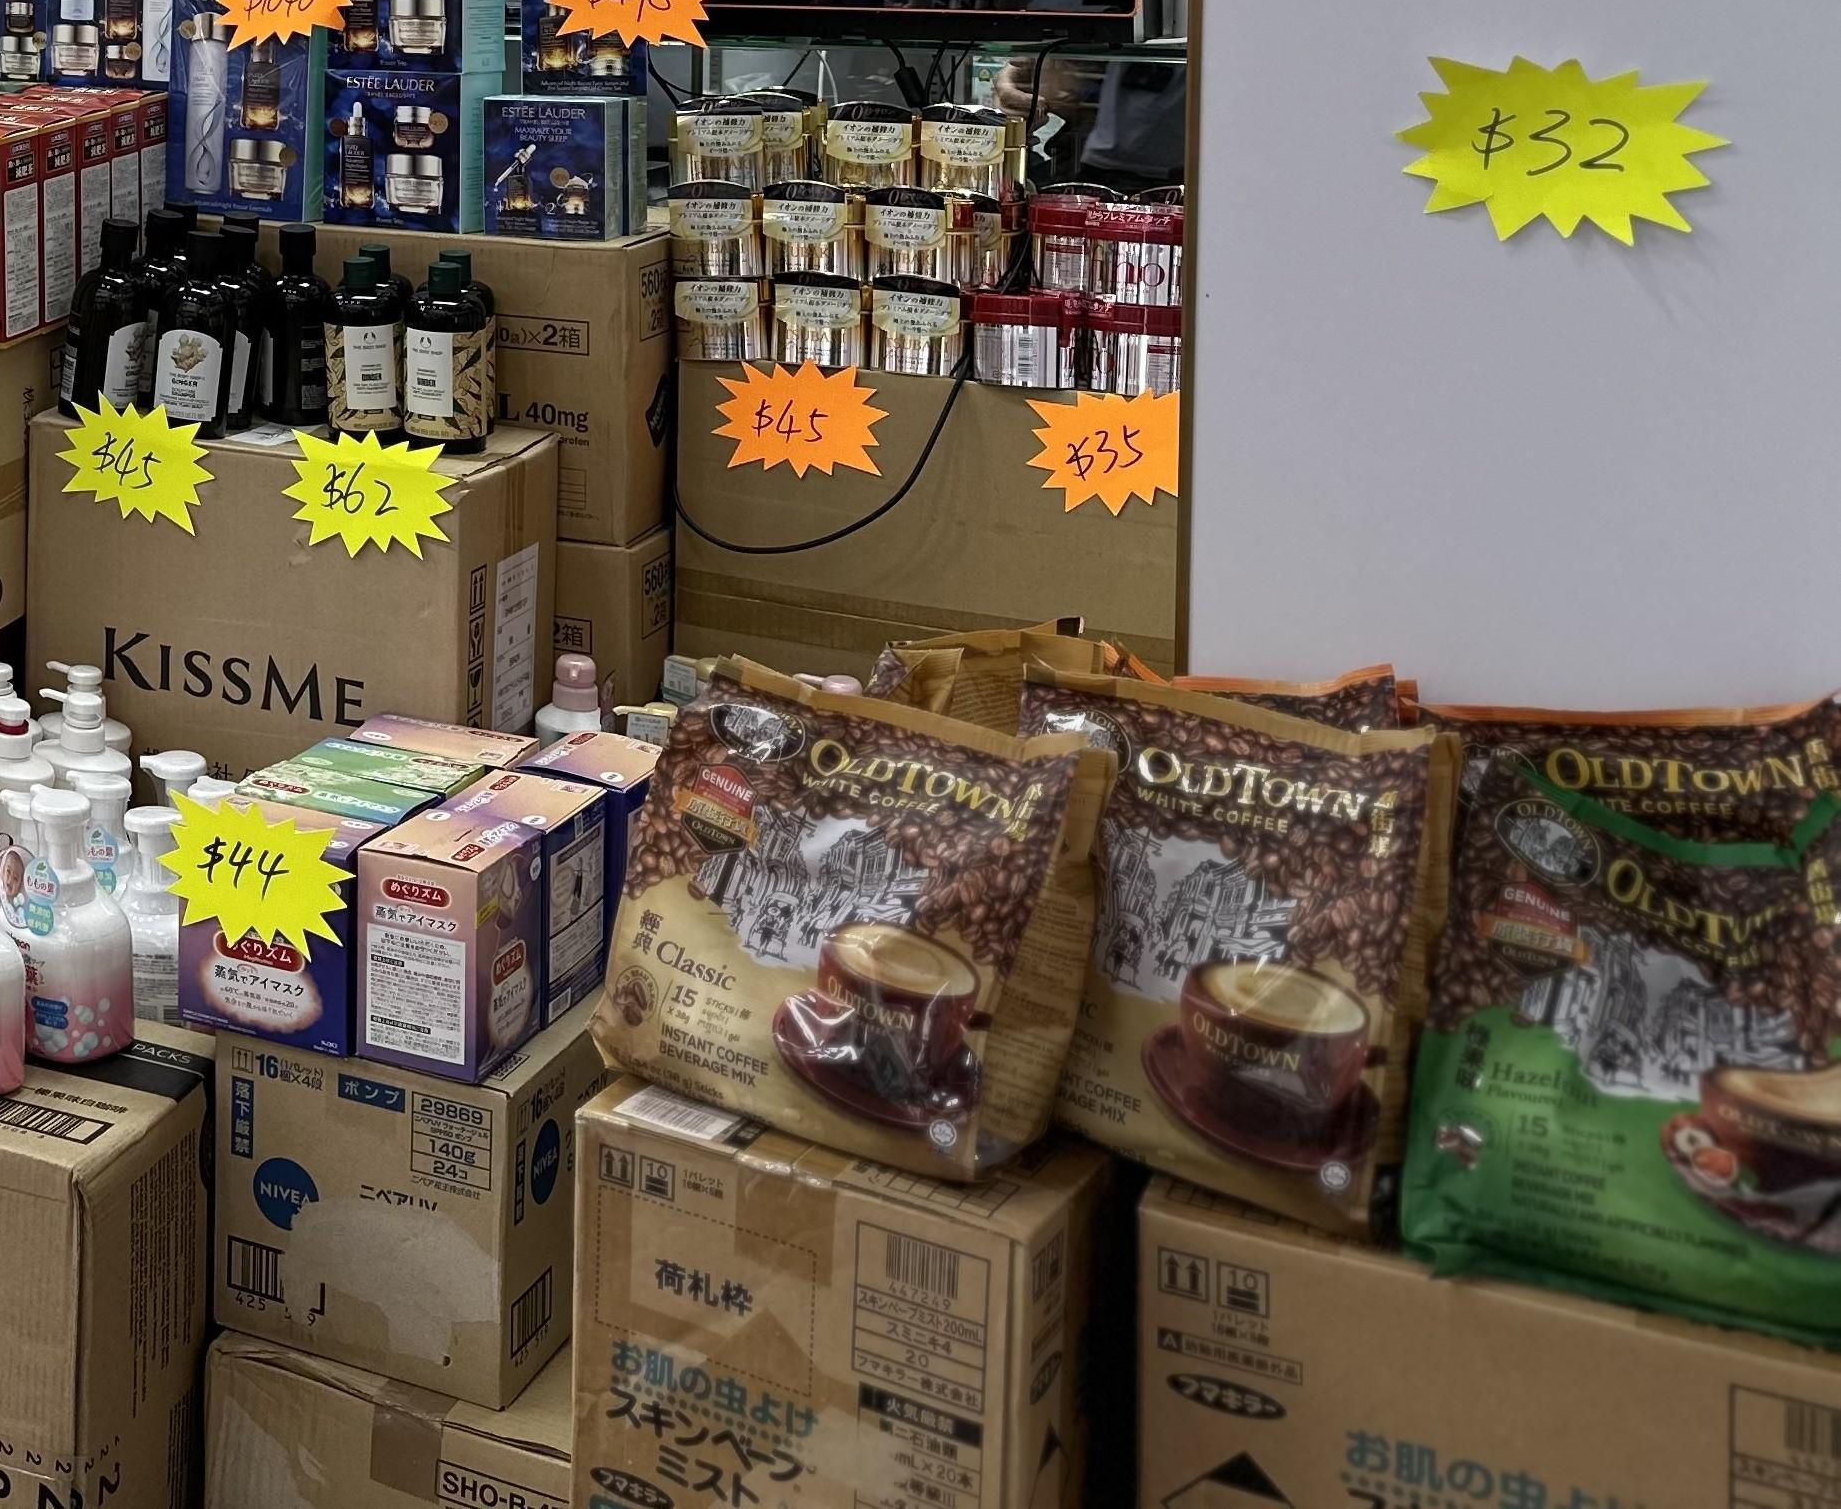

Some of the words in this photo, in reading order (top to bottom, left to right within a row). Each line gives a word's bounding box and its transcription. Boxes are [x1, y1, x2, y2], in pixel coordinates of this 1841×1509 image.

[346, 75, 379, 91] ESTÉE
[381, 76, 435, 92] LAUDER
[501, 106, 534, 120] ESTÉE
[537, 106, 586, 120] LAUDER
[1472, 107, 1630, 177] $32
[526, 402, 589, 432] 40mg
[752, 400, 828, 444] $45
[93, 433, 161, 490] $45
[1065, 426, 1144, 482] $35
[322, 462, 401, 515] $62
[701, 766, 754, 803] GENUINE
[803, 771, 862, 798] WHITE
[869, 792, 939, 816] COFFEE
[1137, 786, 1206, 817] WHITE
[1212, 808, 1290, 835] COFFEE
[197, 836, 289, 900] $44
[390, 880, 442, 902] めぐりズム
[1503, 884, 1571, 921] GENUINE
[375, 905, 457, 933] 蒸気でアイマスク
[639, 909, 662, 954] 經典
[214, 965, 305, 998] 蒸気でアイマスク
[656, 940, 738, 991] Classic
[671, 984, 698, 1008] 15
[133, 1043, 192, 1065] PACKS
[255, 1054, 279, 1080] 16
[658, 1041, 729, 1077] BEVERAGE
[731, 1069, 758, 1089] MIX
[660, 1022, 715, 1054] INSTANT
[716, 1045, 770, 1076] COFFEE
[344, 1080, 400, 1105] ポンプ
[420, 1098, 484, 1125] 29869
[233, 1080, 252, 1155] 落下厳禁
[429, 1139, 476, 1165] 140g
[260, 1182, 311, 1206] NIVEA
[654, 1259, 755, 1317] 荷札枠
[1227, 1268, 1258, 1291] 10
[906, 1349, 929, 1369] 20
[611, 1339, 819, 1439] お肌の虫よけ
[1178, 1376, 1278, 1416] フマキラー
[606, 1388, 805, 1484] スキンベープ
[657, 1446, 761, 1507] ミスト
